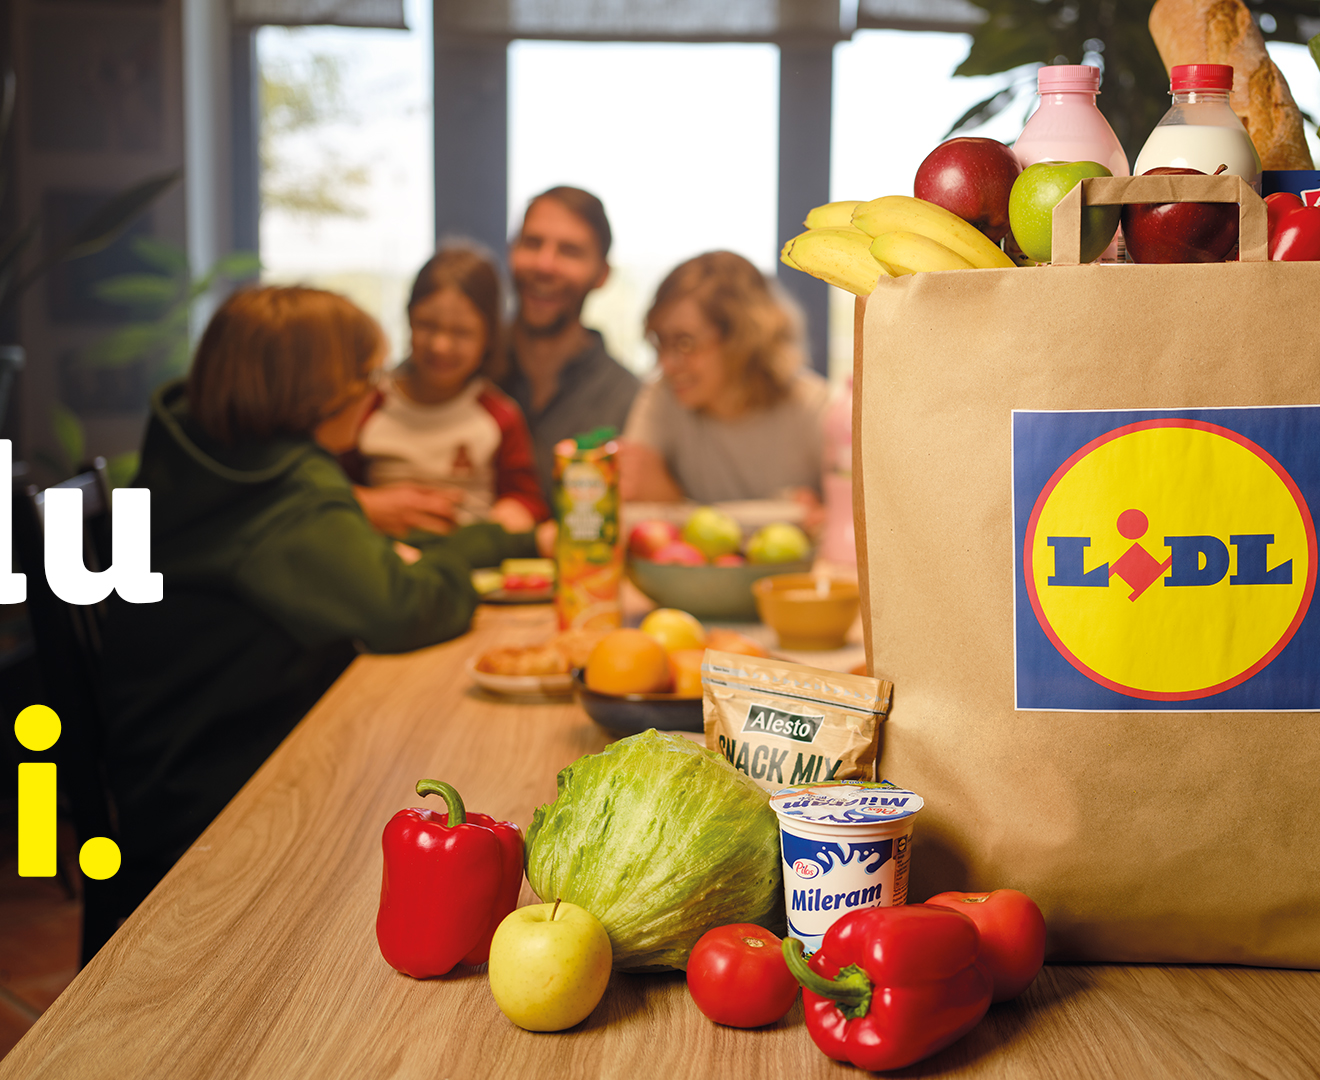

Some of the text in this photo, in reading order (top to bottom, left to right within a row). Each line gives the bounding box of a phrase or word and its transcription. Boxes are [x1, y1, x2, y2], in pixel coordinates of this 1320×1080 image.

[750, 711, 811, 737] Alesto
[719, 735, 843, 785] SNACK MIX
[795, 861, 814, 876] Pilos
[792, 883, 882, 911] Mileram
